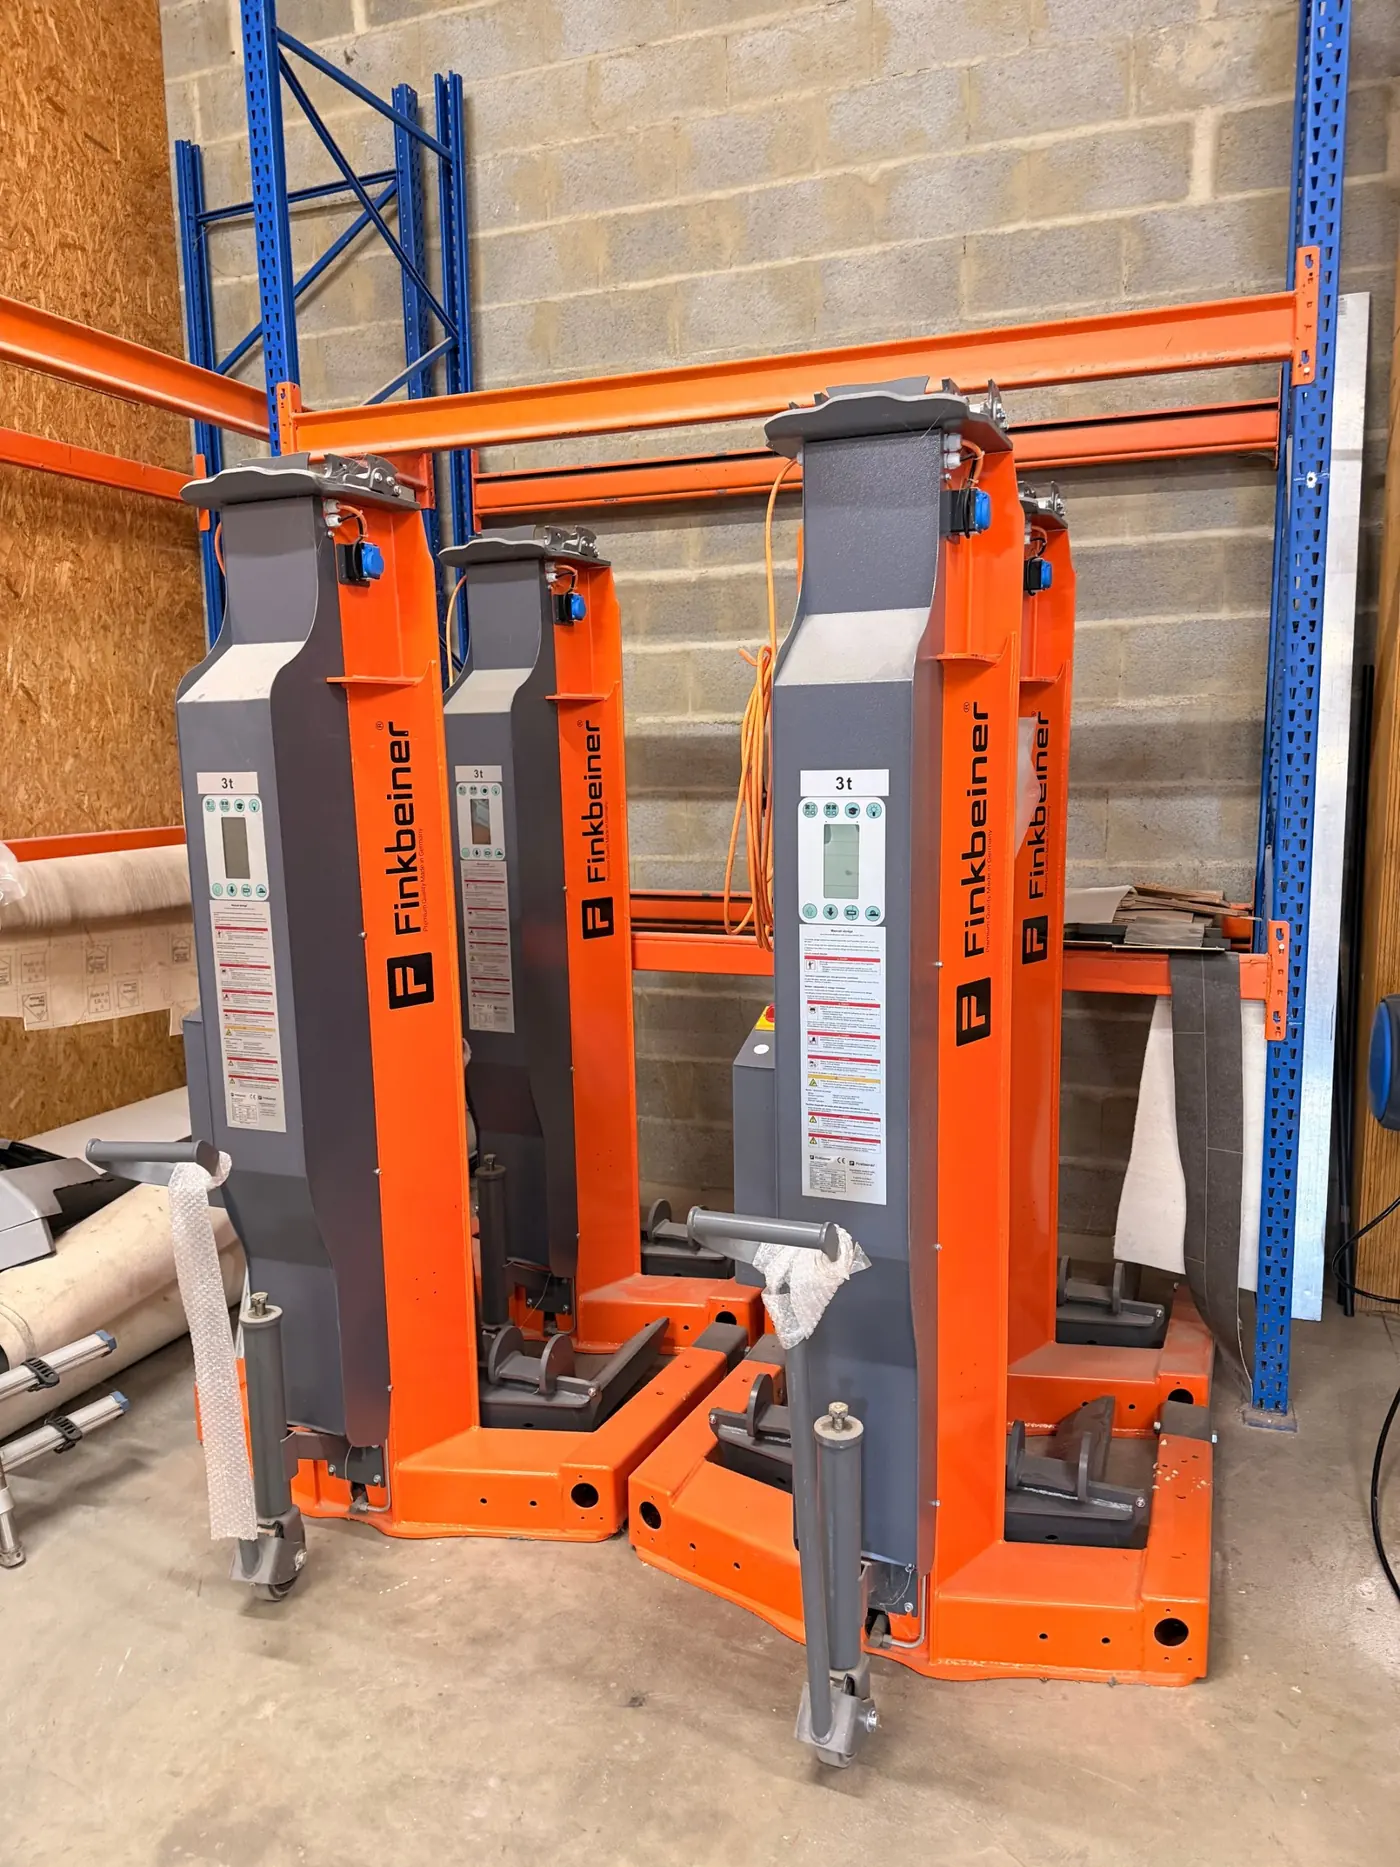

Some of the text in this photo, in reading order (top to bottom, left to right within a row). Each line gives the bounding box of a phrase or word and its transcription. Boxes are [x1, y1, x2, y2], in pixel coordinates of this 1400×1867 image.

[384, 721, 421, 936] Finkbeiner
[581, 720, 606, 883] Finkbeiner
[961, 701, 989, 958] Finkbeiner
